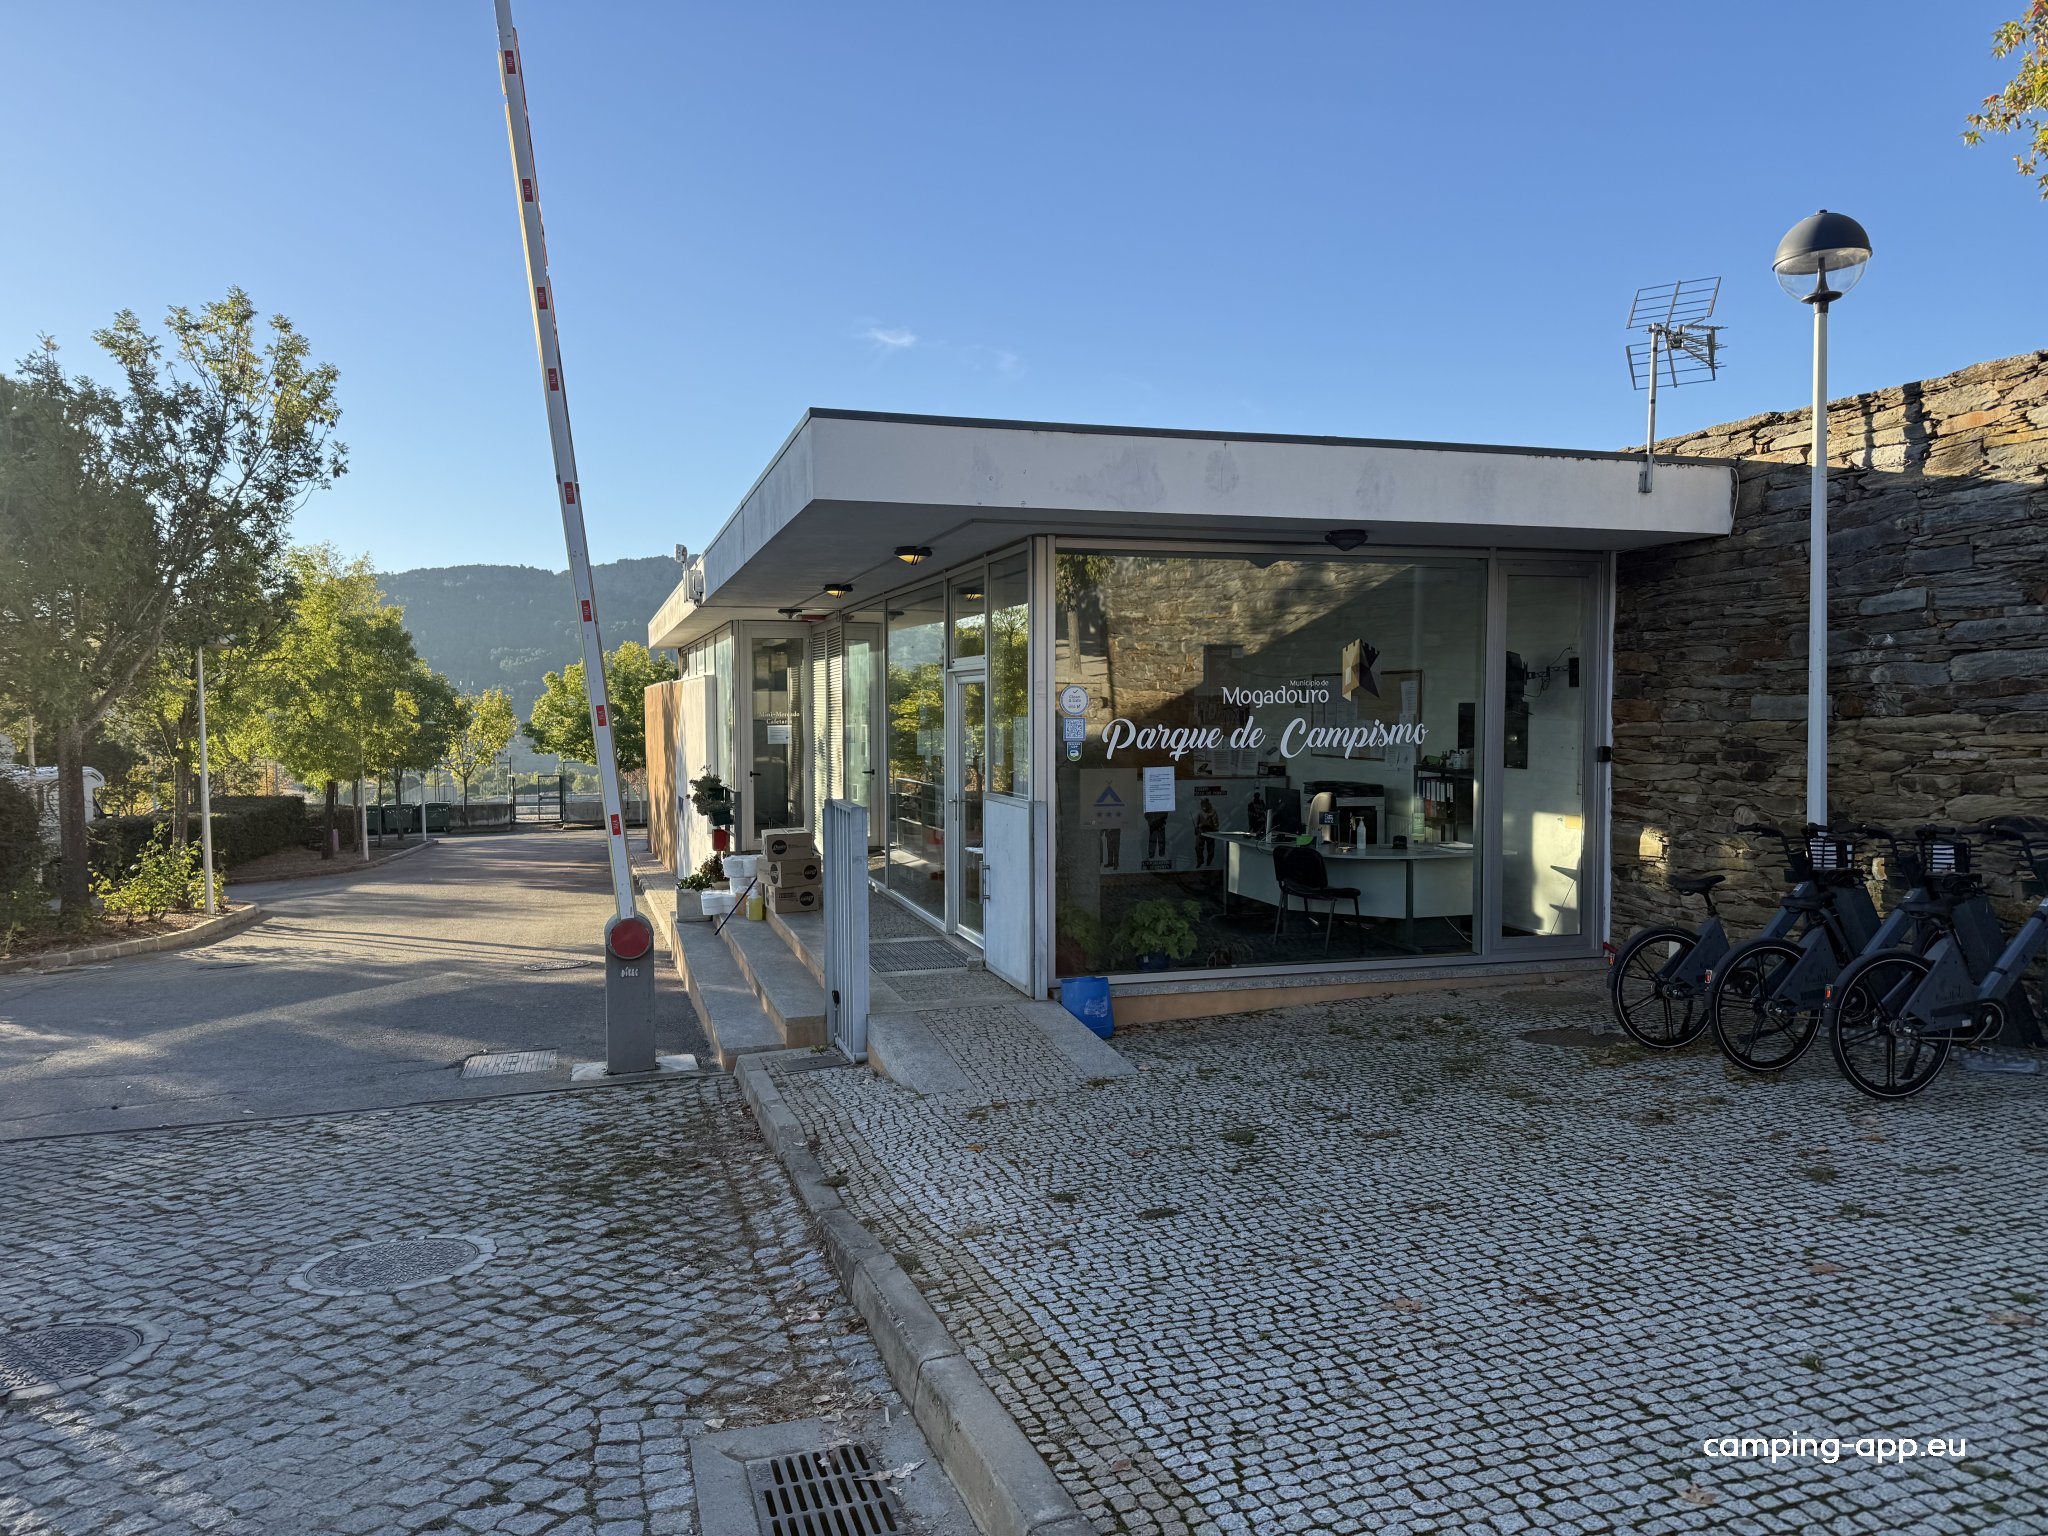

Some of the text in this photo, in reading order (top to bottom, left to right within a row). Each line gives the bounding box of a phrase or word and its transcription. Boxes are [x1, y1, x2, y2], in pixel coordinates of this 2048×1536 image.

[1221, 686, 1329, 708] Mogadouro
[1101, 715, 1429, 761] Parque de Campismo
